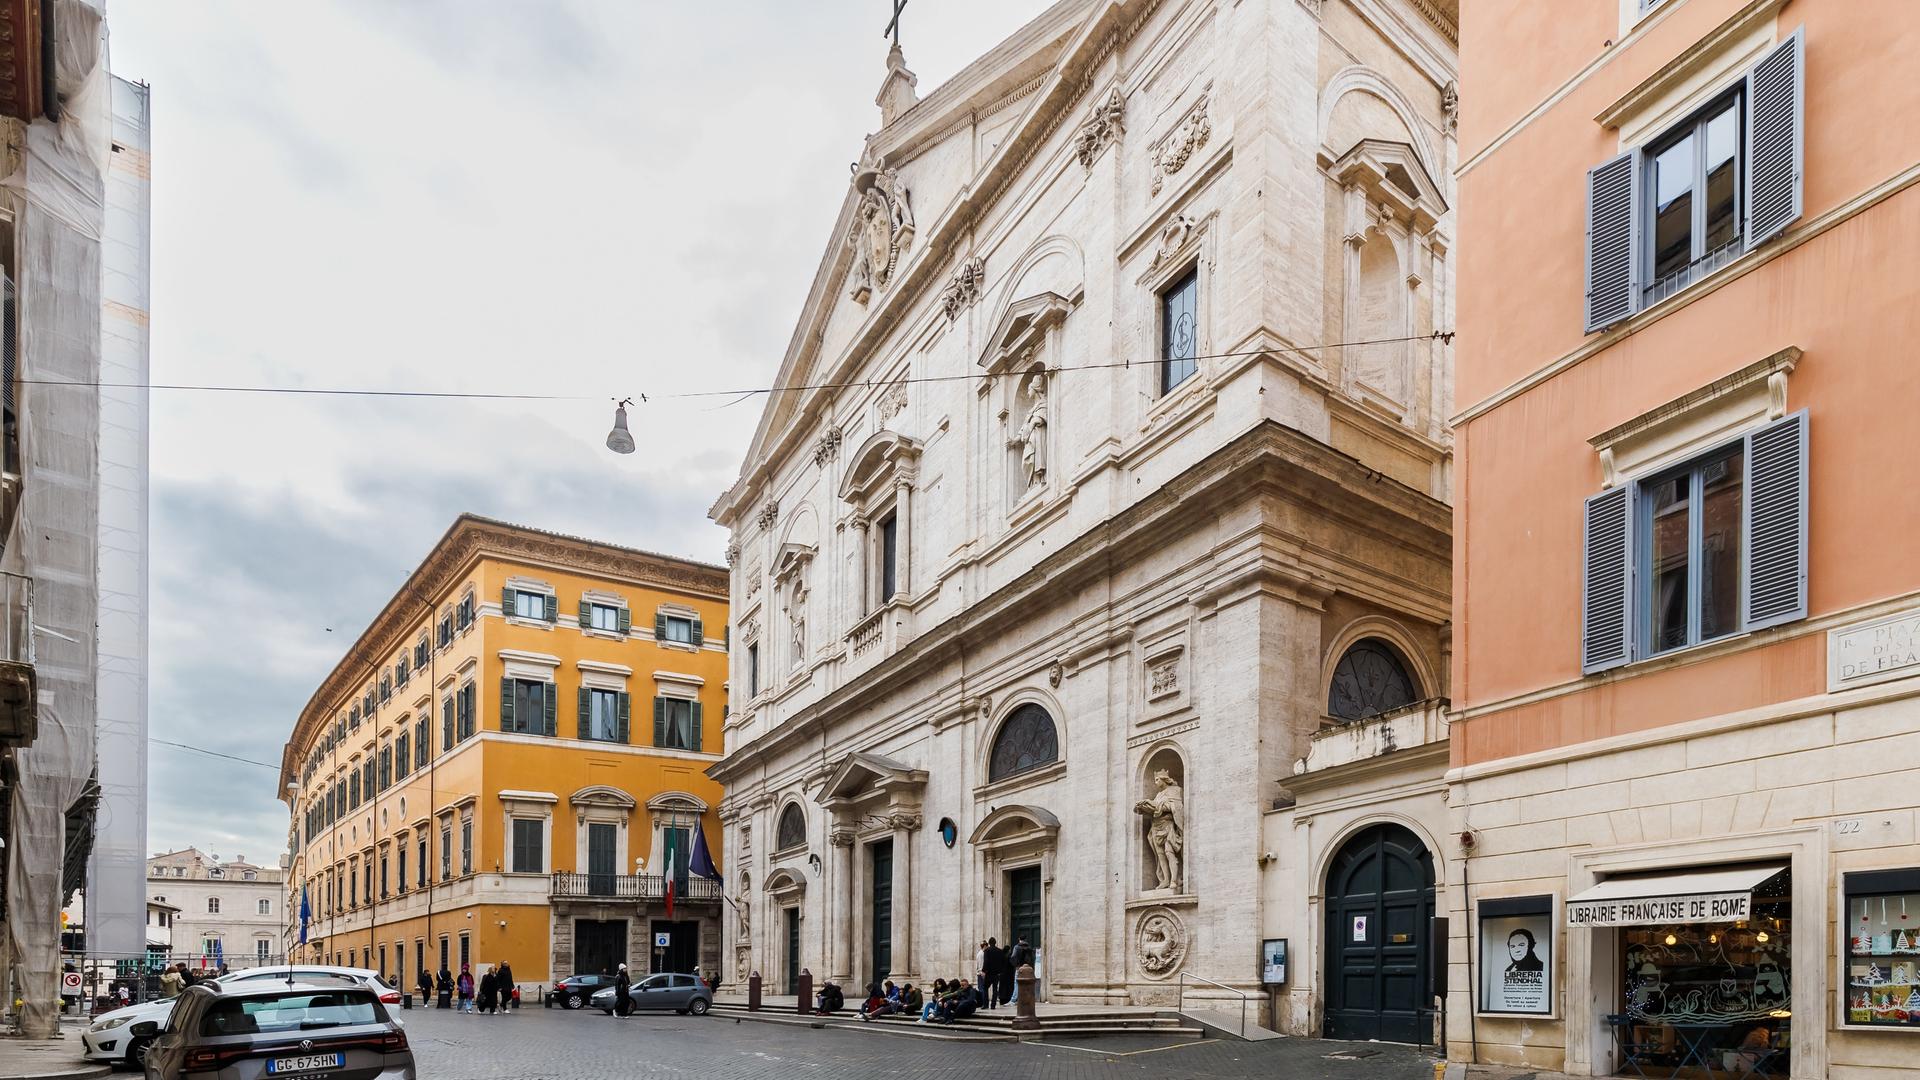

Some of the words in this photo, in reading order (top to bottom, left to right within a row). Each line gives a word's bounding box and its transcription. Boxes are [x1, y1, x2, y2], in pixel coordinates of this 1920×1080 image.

[1838, 821, 1861, 835] 22
[1569, 905, 1617, 923] LIBRAIRIE
[1621, 901, 1685, 922] FRANÇAISE
[1690, 900, 1706, 918] DE
[1711, 898, 1747, 917] ROME
[276, 1059, 293, 1071] GG
[297, 1054, 336, 1069] 675HN
